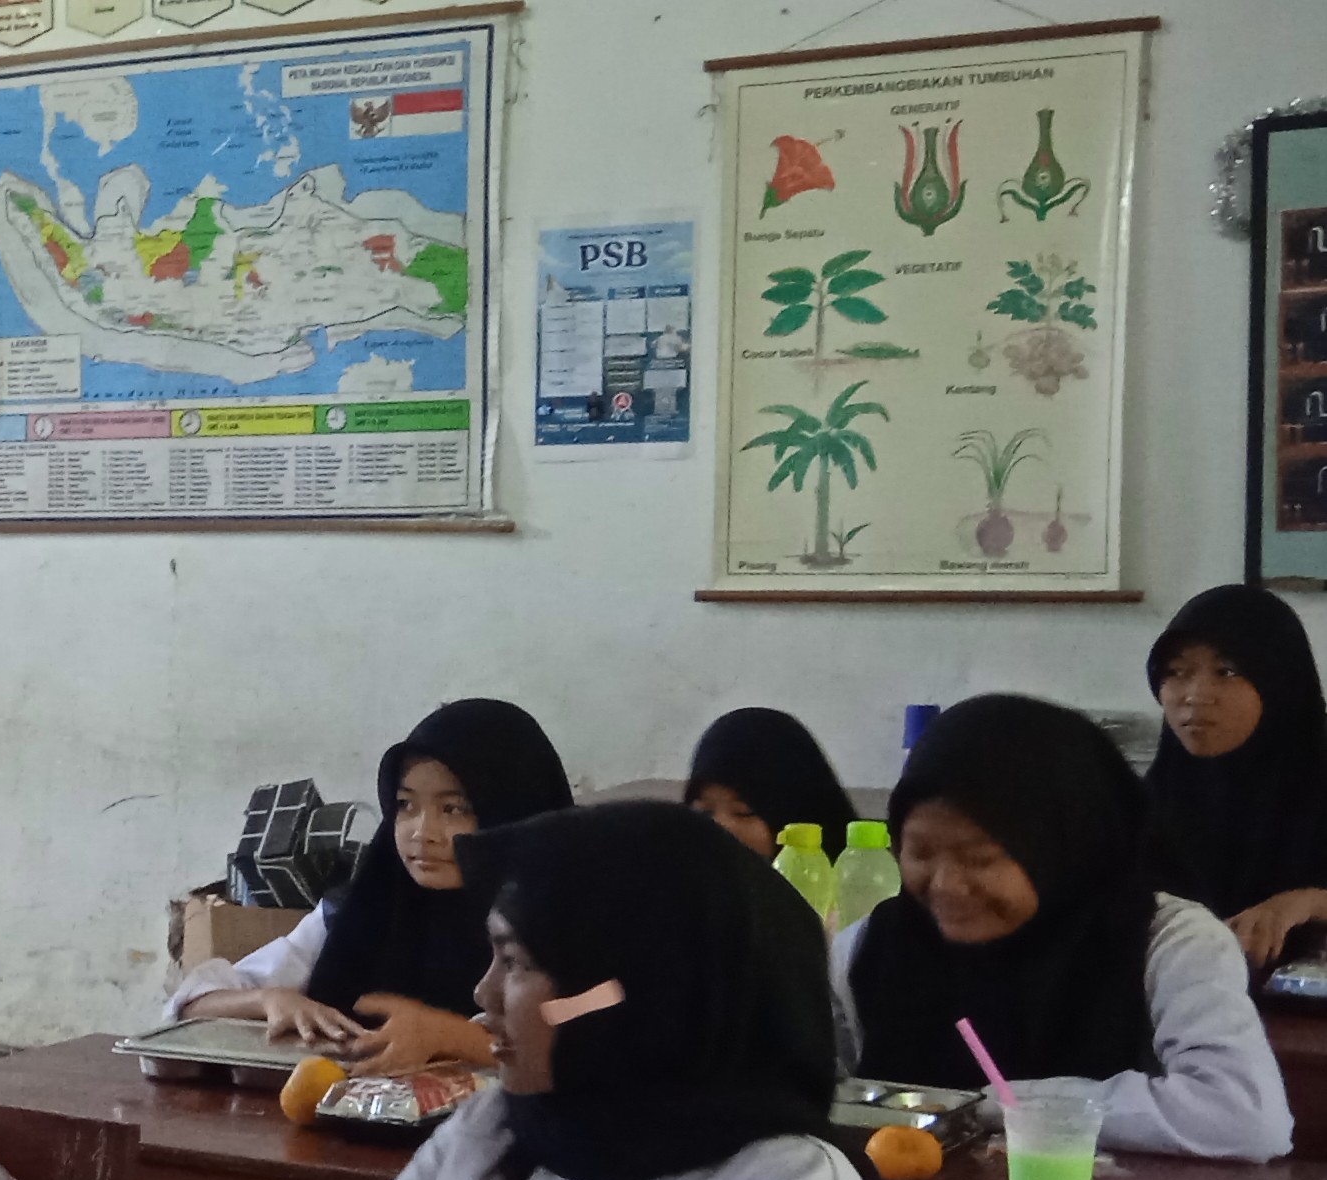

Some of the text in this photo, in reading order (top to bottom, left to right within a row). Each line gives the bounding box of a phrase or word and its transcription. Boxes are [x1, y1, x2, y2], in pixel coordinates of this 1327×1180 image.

[968, 67, 1055, 86] TUMBUHAN
[890, 100, 960, 115] GENERATIF
[579, 240, 649, 271] PSB
[895, 261, 963, 275] VEGETATIF
